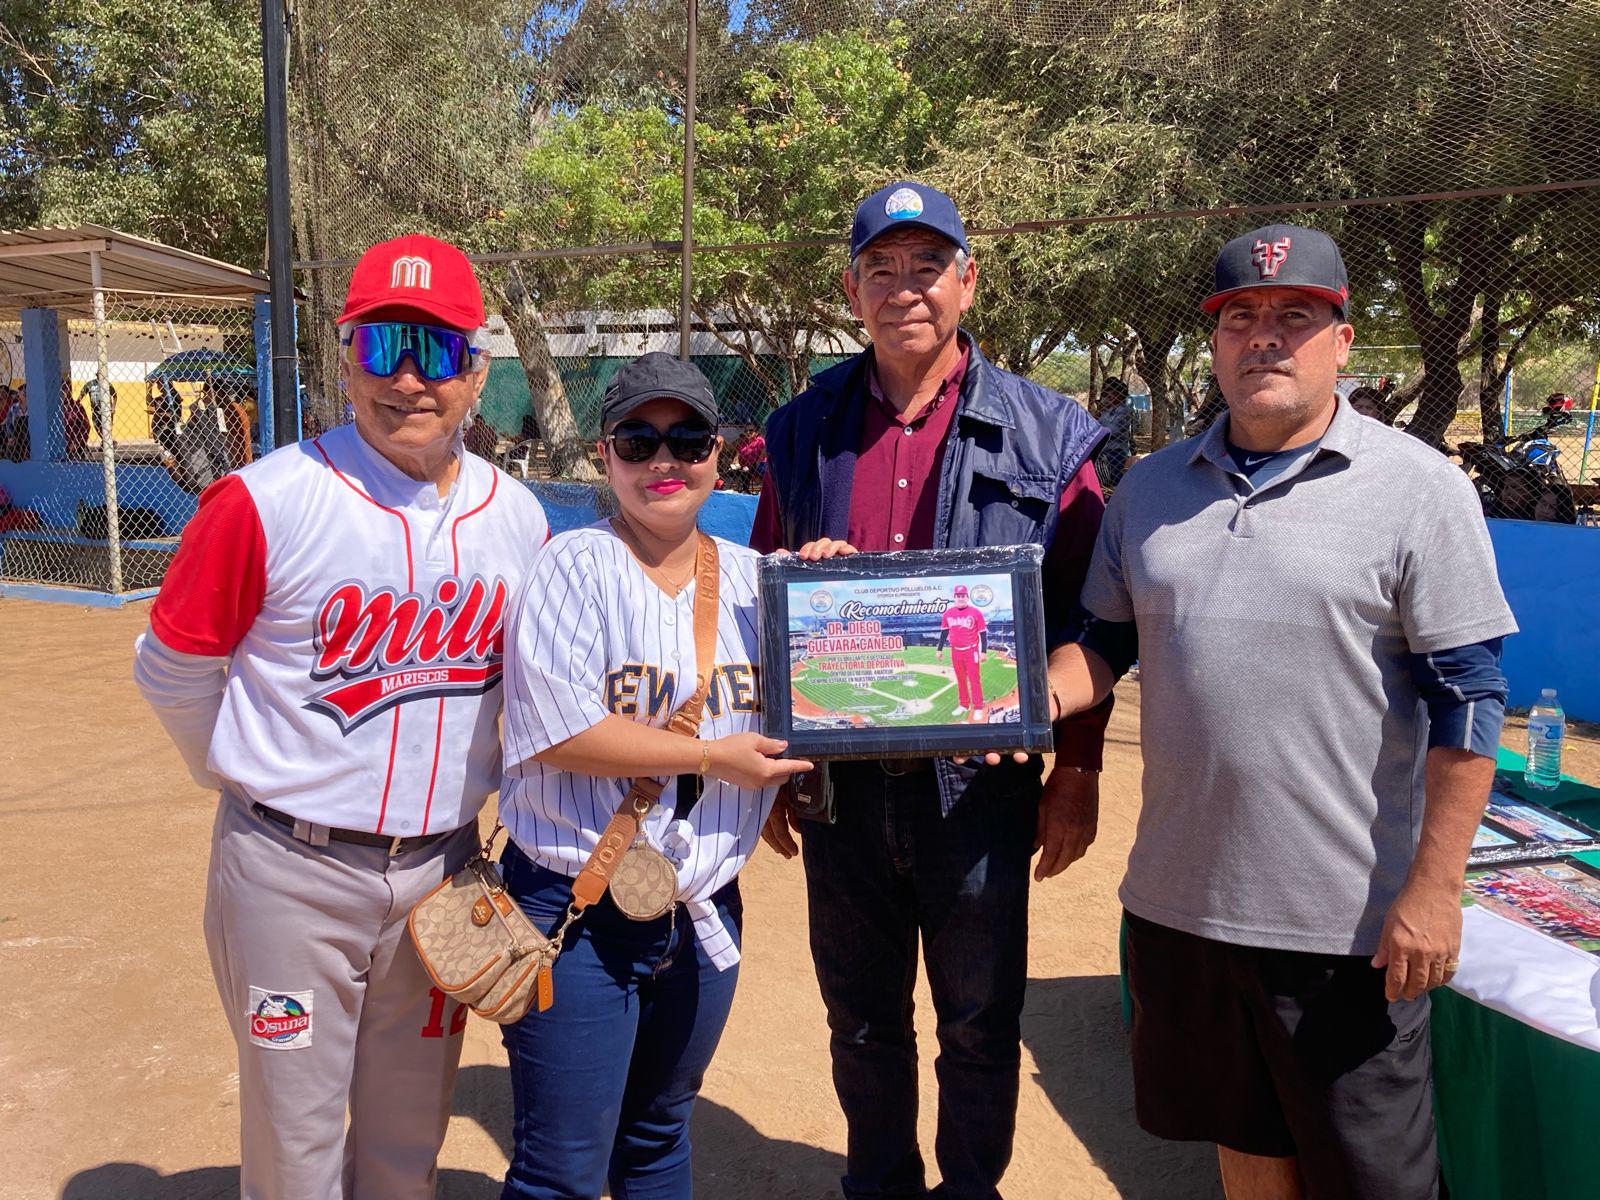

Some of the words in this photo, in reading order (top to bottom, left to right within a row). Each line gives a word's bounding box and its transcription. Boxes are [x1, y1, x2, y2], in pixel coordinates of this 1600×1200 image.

[701, 540, 717, 600] COACH
[869, 586, 900, 594] DEPORTIVO
[840, 598, 949, 620] Reconocimiento
[828, 622, 846, 636] DR.
[848, 621, 881, 635] DIEGO
[808, 638, 857, 653] GUEVARA
[859, 634, 903, 651] CAÑEDO
[818, 660, 865, 671] TRAYECTORIA
[866, 659, 905, 669] DEPORTIVA
[381, 669, 450, 695] MARISCOS
[254, 1017, 308, 1034] Osuna
